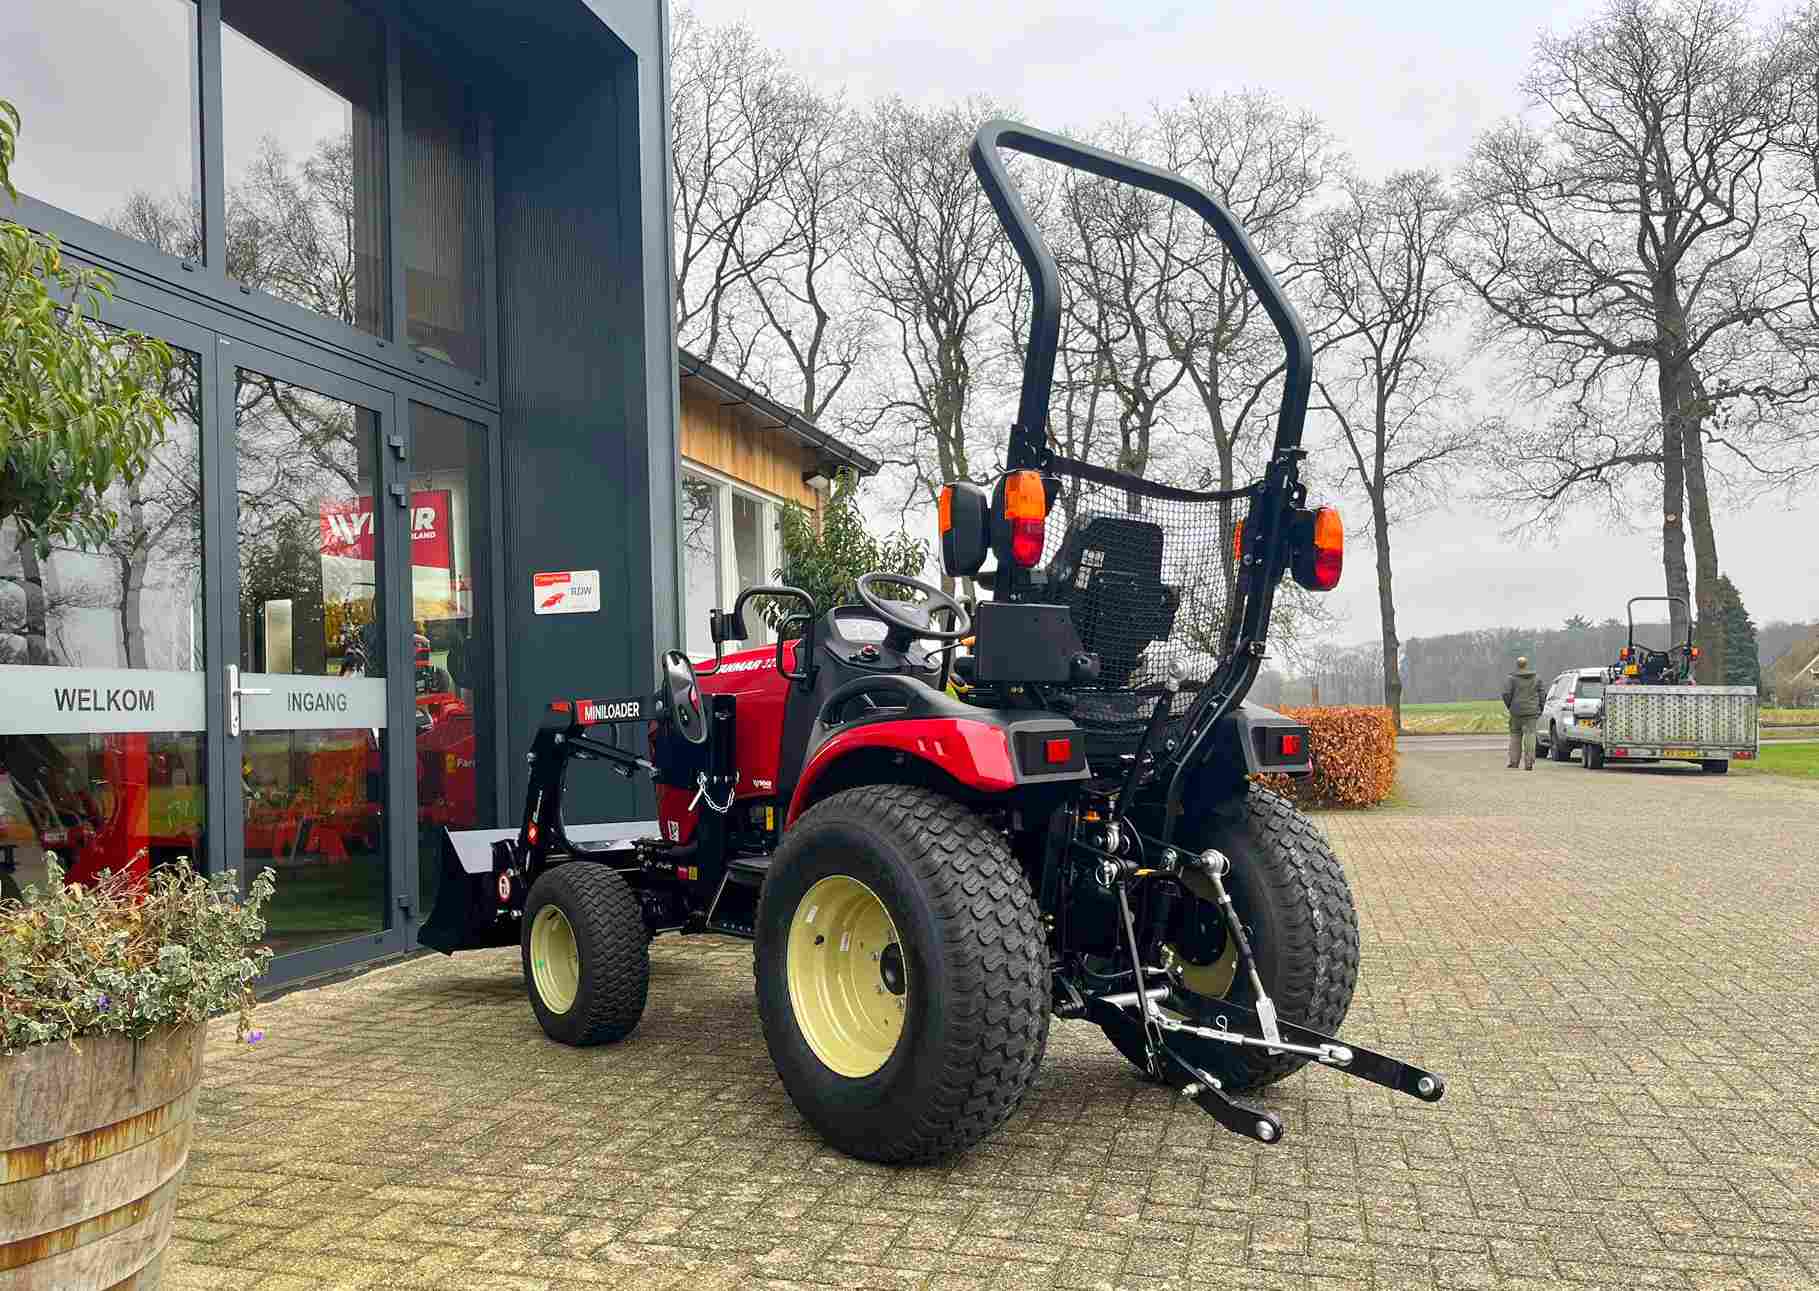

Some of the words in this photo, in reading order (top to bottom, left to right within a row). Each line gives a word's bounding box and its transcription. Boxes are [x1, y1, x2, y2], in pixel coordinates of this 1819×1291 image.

[54, 688, 155, 712] WELKOM
[287, 691, 348, 712] INGANG
[583, 701, 640, 721] MINILOADER
